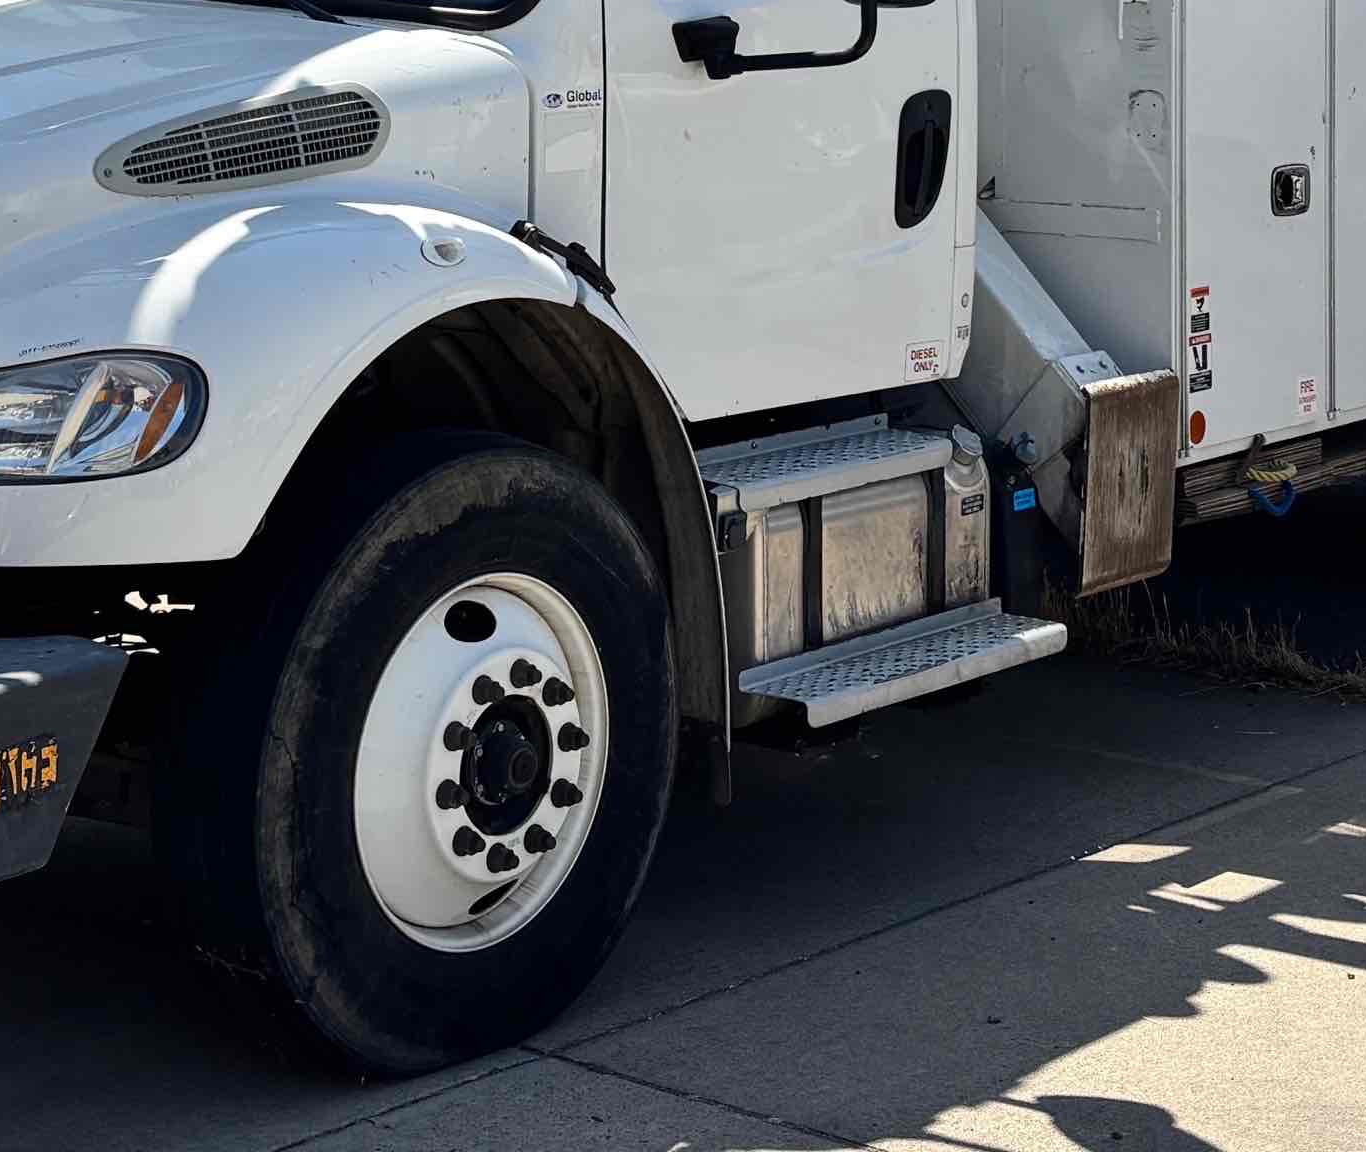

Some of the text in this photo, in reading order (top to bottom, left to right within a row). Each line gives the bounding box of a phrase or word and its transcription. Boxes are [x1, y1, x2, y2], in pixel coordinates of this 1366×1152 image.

[566, 89, 602, 102] Global
[910, 347, 938, 361] DIESEL
[914, 360, 933, 373] ONLY
